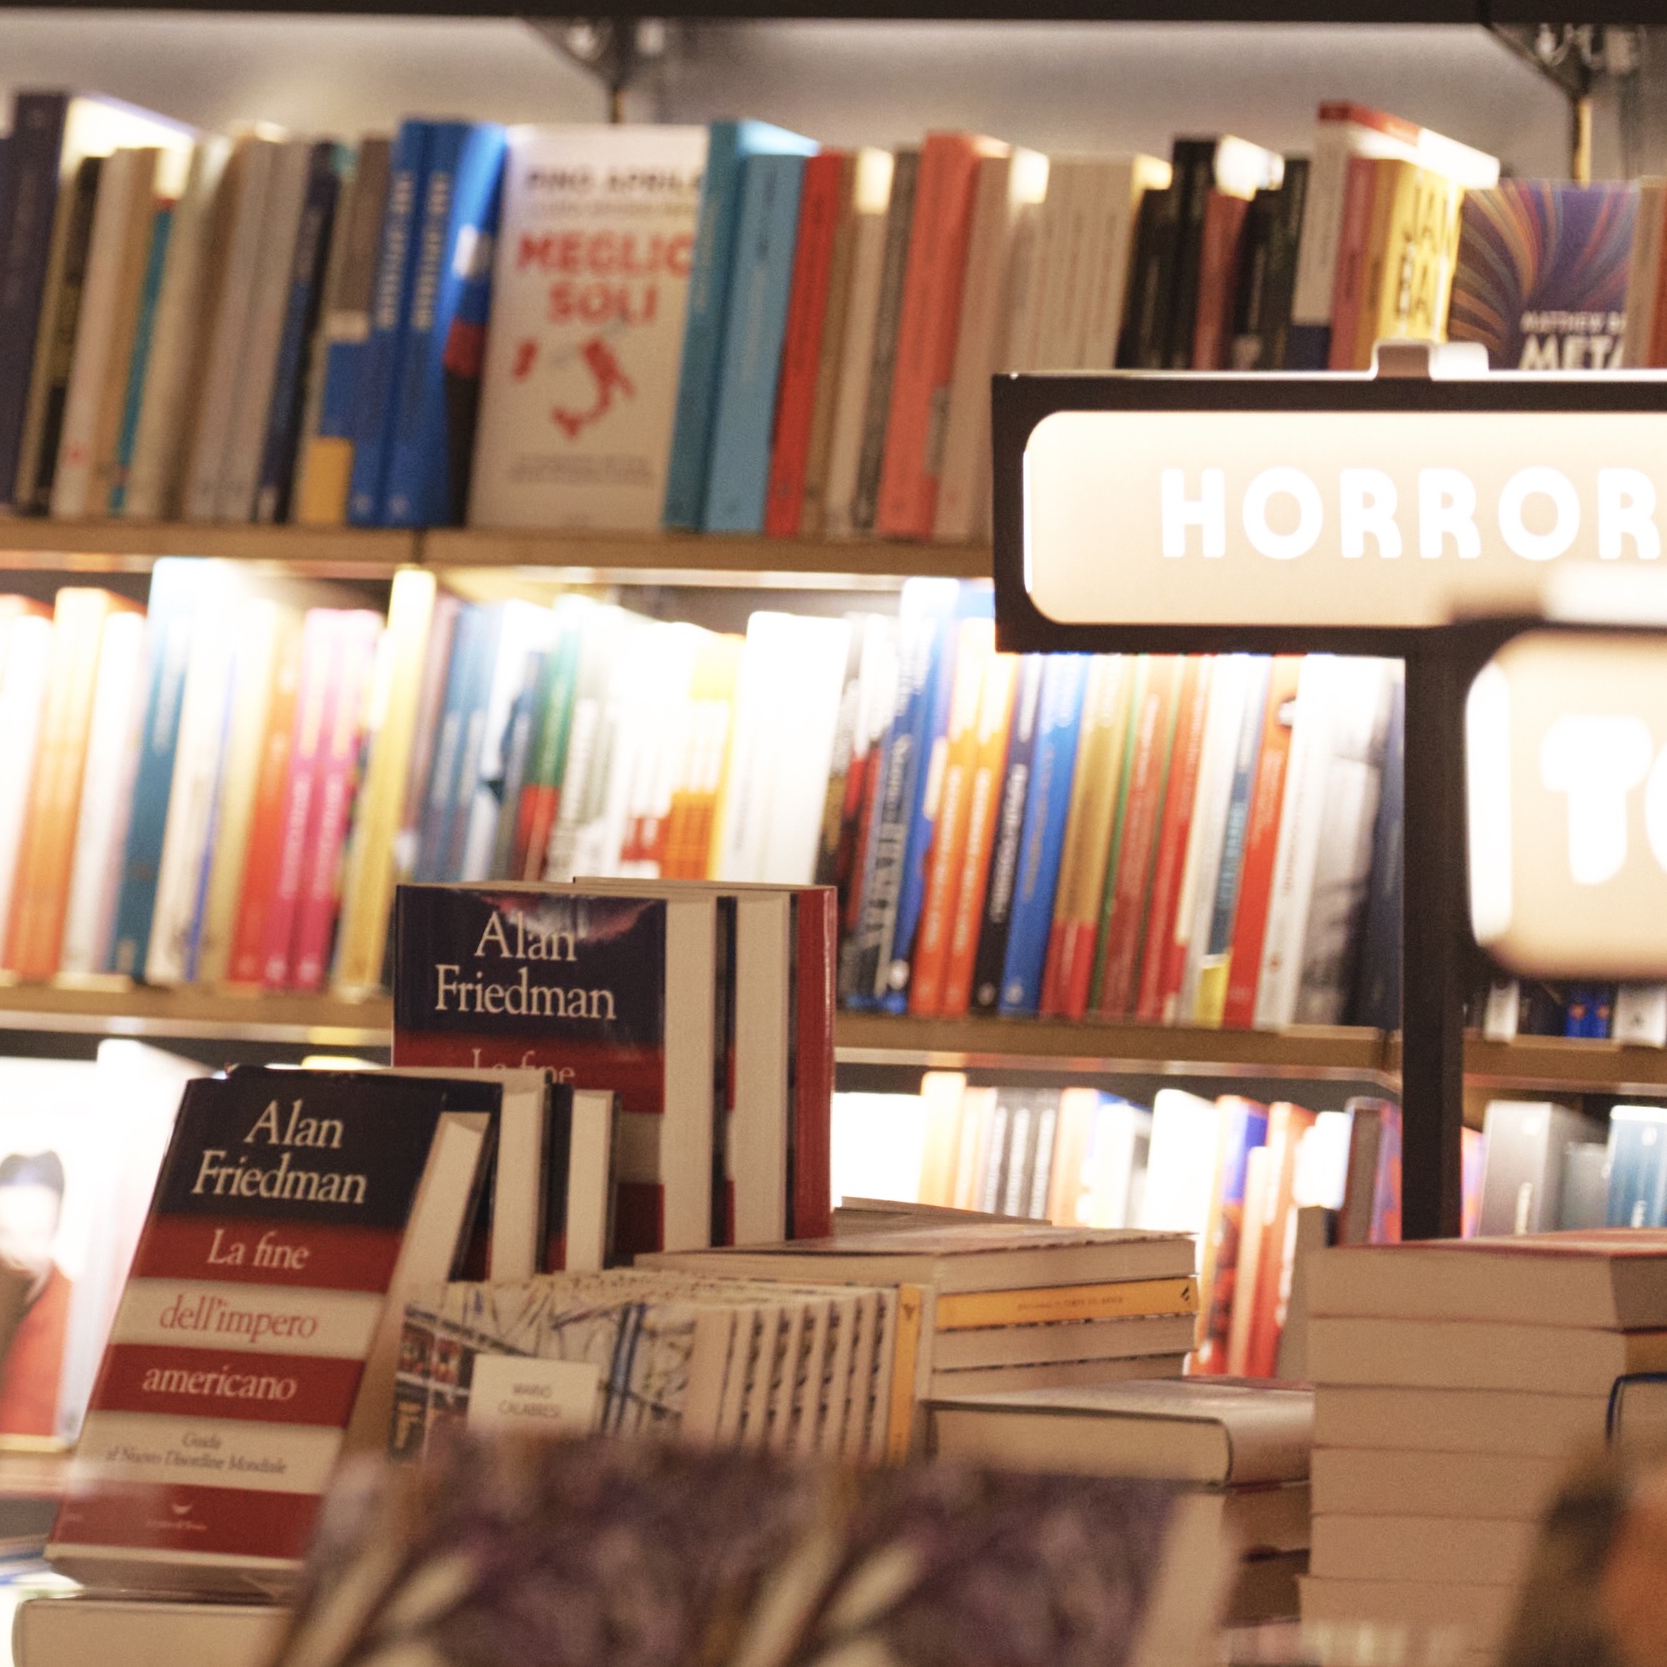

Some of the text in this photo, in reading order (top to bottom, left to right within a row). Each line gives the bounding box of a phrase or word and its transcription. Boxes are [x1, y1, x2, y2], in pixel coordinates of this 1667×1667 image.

[518, 231, 694, 277] MEGLIO
[549, 281, 658, 325] SOLI
[1161, 465, 1661, 561] HORROR
[1540, 714, 1667, 885] T
[474, 911, 578, 962] Alan
[435, 964, 617, 1019] Friedman
[243, 1099, 344, 1149] Alan
[191, 1150, 367, 1204] Friedman
[207, 1229, 310, 1270] La fine
[159, 1294, 319, 1343] dell'impero
[142, 1363, 298, 1402] americano
